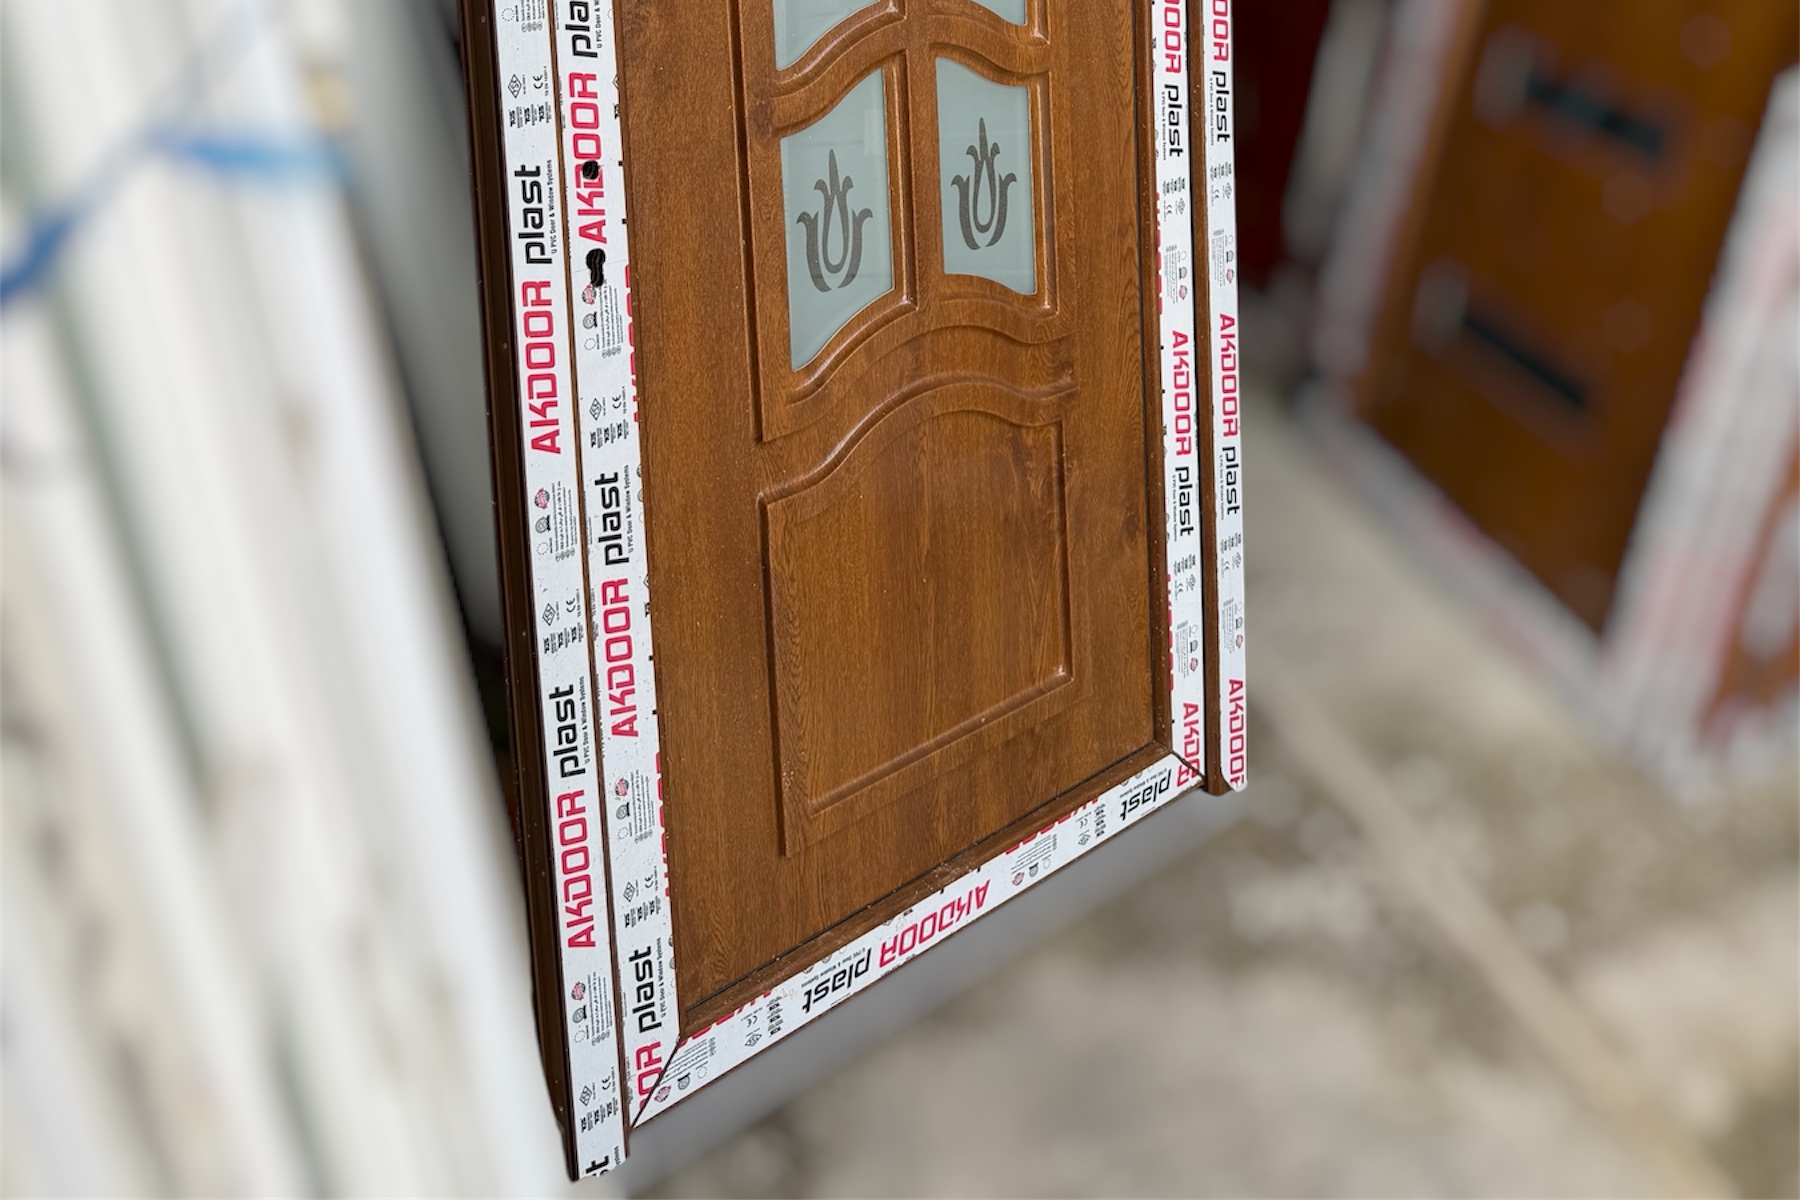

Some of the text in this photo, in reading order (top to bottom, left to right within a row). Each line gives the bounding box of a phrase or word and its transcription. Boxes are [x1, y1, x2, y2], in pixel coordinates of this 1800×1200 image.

[1165, 84, 1183, 158] plast
[1212, 70, 1230, 143] plast
[514, 164, 552, 264] plast
[521, 280, 562, 455] AKDOOR
[1219, 313, 1240, 515] AKDOOR plast
[1171, 330, 1194, 537] AKDOOR plast
[595, 472, 629, 565] plast
[601, 577, 639, 738] AKDOOR
[549, 684, 586, 778] plast
[1120, 769, 1171, 821] plast
[556, 788, 596, 949] AKDOOR
[629, 945, 662, 1033] plast
[803, 879, 991, 1014] AKDOOR plast
